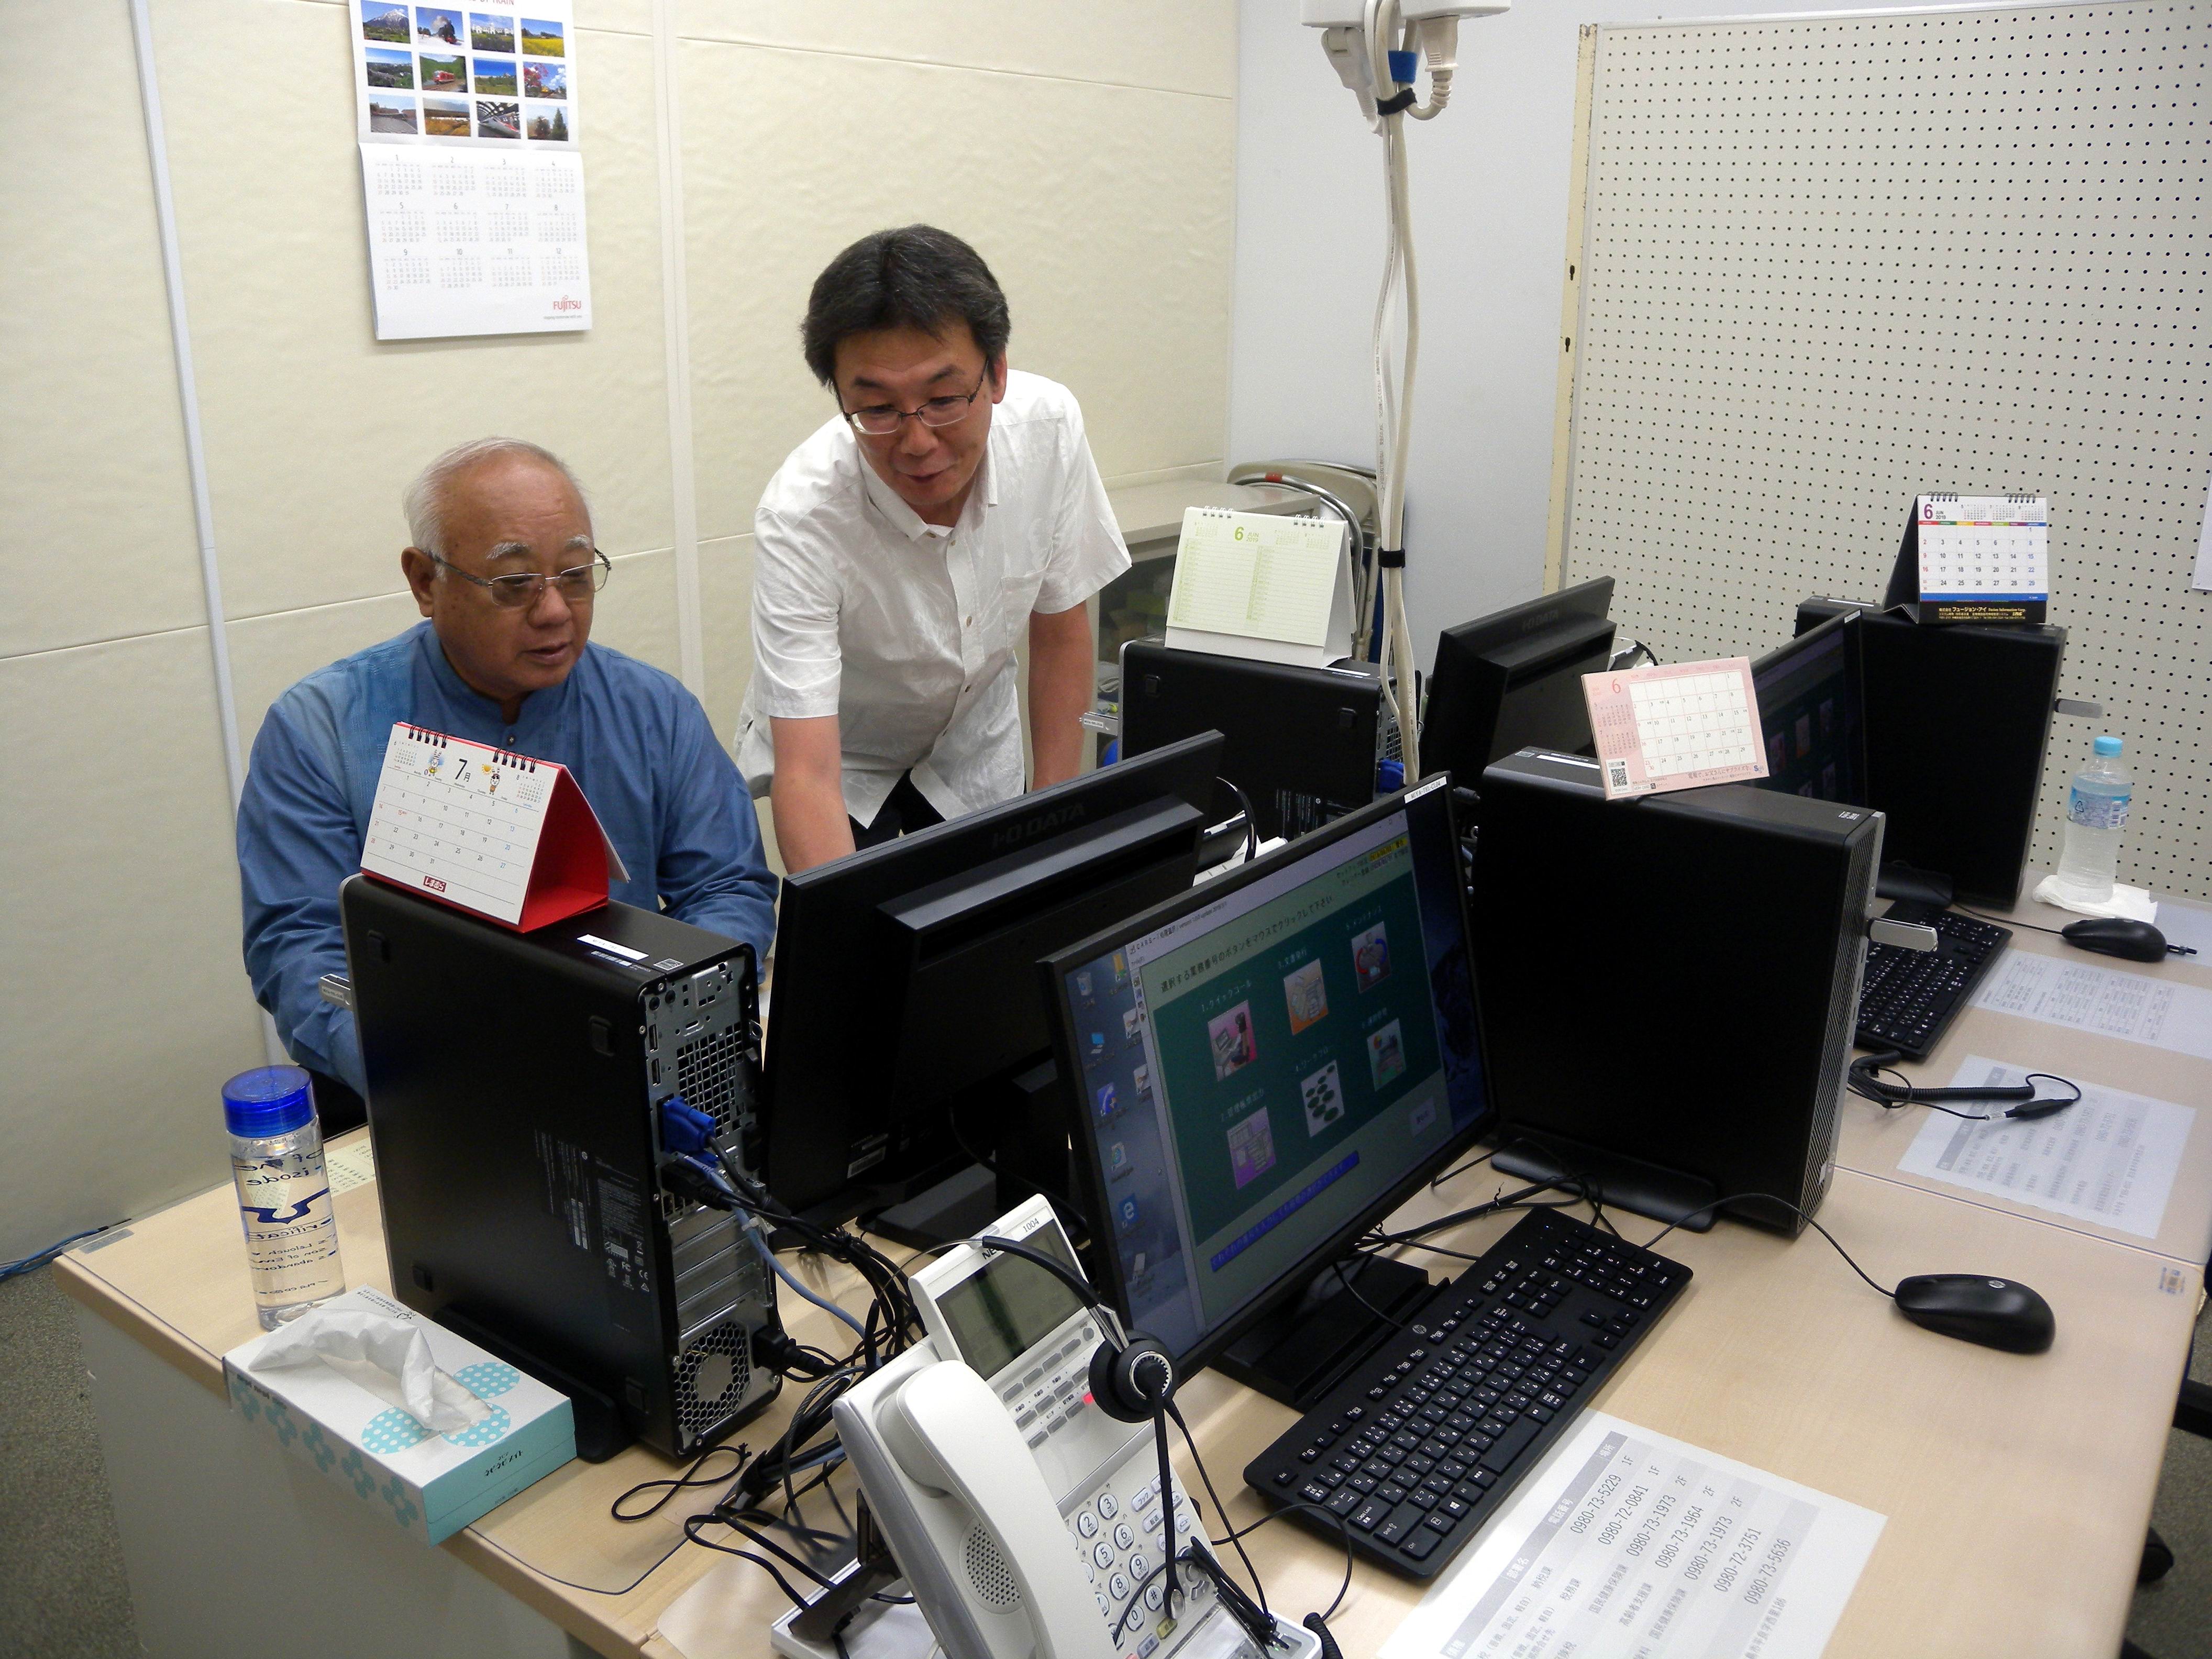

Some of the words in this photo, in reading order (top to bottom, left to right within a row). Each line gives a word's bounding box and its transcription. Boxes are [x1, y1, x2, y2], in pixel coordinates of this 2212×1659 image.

[554, 295, 581, 312] FUJITSU
[1924, 504, 1933, 519] 6
[1234, 526, 1245, 541] 6
[1612, 678, 1621, 694] 6
[425, 877, 445, 891] しまむら
[1023, 1218, 1039, 1232] 1004
[1138, 1494, 1149, 1505] フック
[1570, 1474, 1621, 1534] 0980-73-5229
[1622, 1455, 1634, 1466] 1F
[1104, 1498, 1111, 1509] 3
[1598, 1485, 1649, 1545] 0980-72-0841
[1649, 1465, 1661, 1476] 1F
[1084, 1517, 1092, 1527] 2
[1626, 1495, 1676, 1557] 0980-73-1973
[1675, 1475, 1687, 1487] 2F
[1121, 1529, 1127, 1540] 6
[1383, 1526, 1391, 1535] Shift
[1655, 1506, 1704, 1569] 0980-73-1964
[1703, 1486, 1715, 1497] 2F
[1685, 1516, 1733, 1580] 0980-73-1973
[1731, 1496, 1743, 1507] 2F
[1101, 1547, 1108, 1558] 5
[1135, 1560, 1142, 1570] 9
[1713, 1527, 1762, 1593] 0980-72-3751
[1744, 1538, 1791, 1605] 0980-73-5636
[1116, 1578, 1123, 1588] 8
[1131, 1610, 1137, 1620] 0
